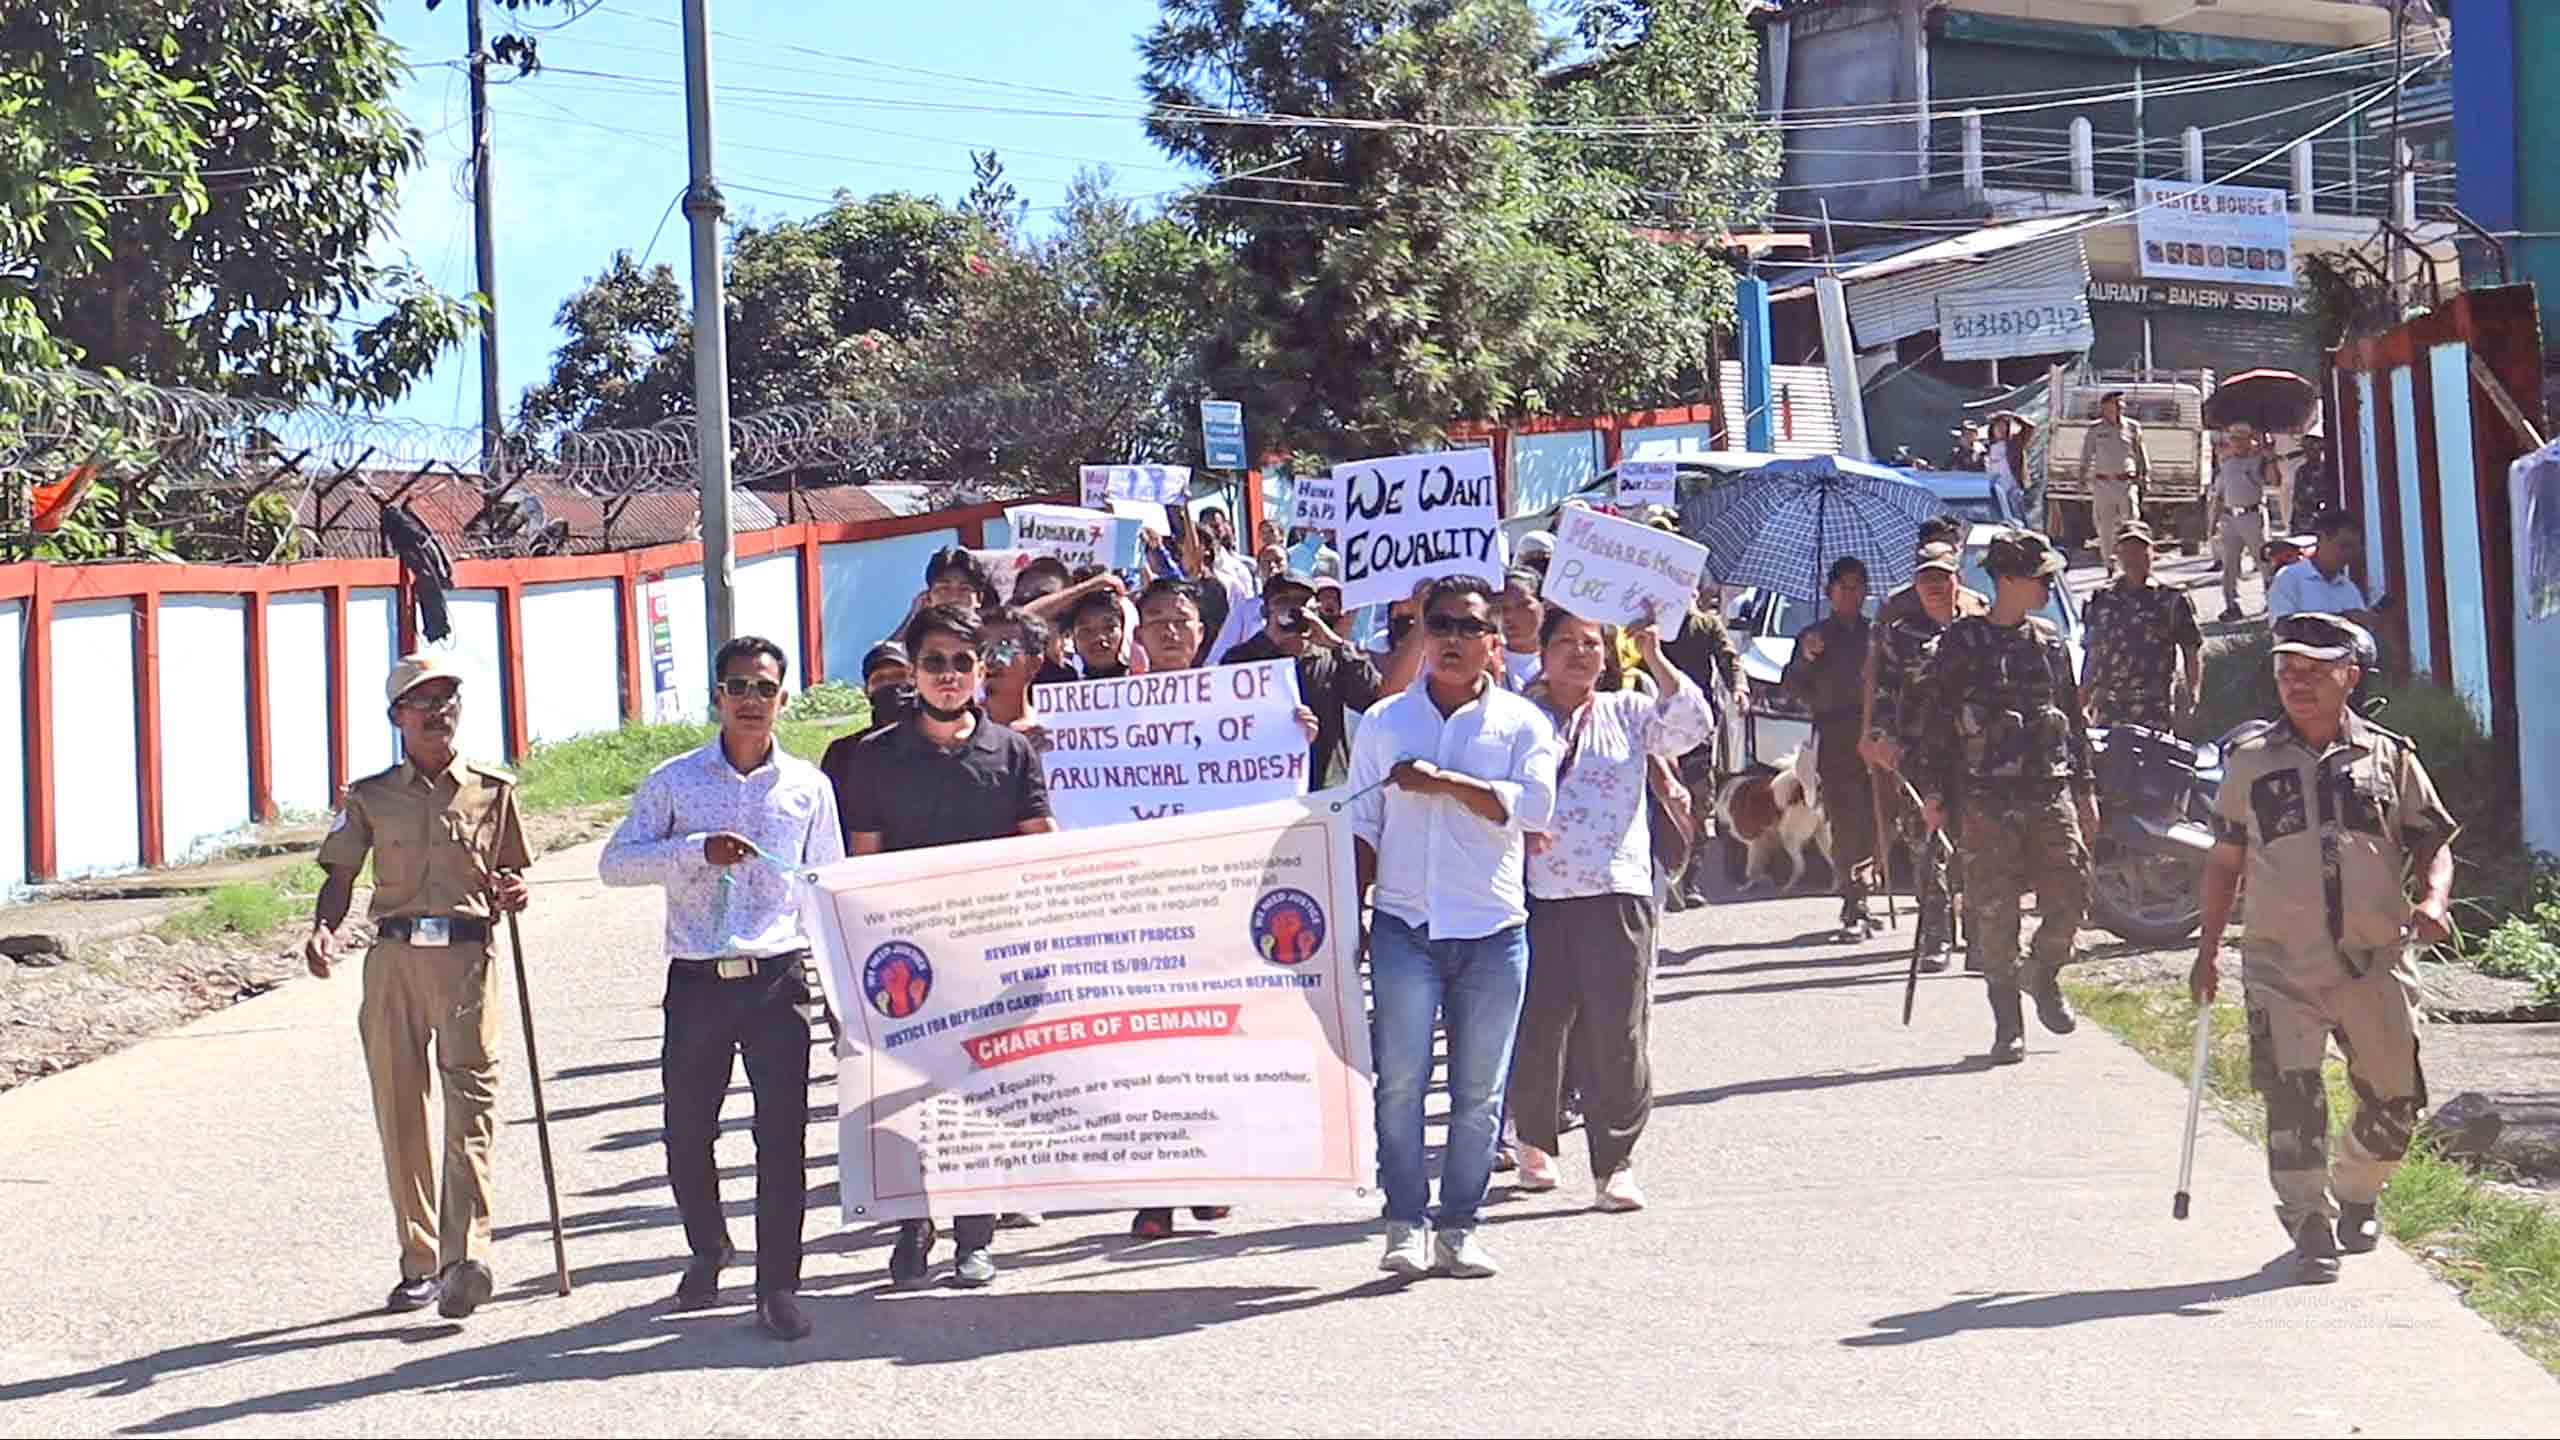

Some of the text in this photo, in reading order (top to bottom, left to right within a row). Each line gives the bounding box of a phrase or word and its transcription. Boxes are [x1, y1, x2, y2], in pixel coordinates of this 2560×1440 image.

[2215, 196, 2268, 215] HOUSE
[2168, 287, 2229, 310] BAKERY
[2233, 294, 2287, 313] SISTER
[1037, 665, 1274, 714] DIRECTORATE OF
[1043, 724, 1119, 752] SPORTS
[1217, 714, 1256, 743] OF
[1049, 751, 1308, 791] ARUNACHAL PRADESH
[890, 901, 943, 922] request
[946, 895, 974, 912] that
[1014, 886, 1041, 900] and
[1127, 865, 1199, 886] guidelines
[1202, 862, 1220, 876] be
[1223, 855, 1303, 873] established
[891, 913, 958, 938] regarding
[960, 902, 1021, 923] eligibility
[1023, 898, 1044, 912] for
[1047, 893, 1070, 909] the
[1073, 890, 1116, 909] sports
[1167, 877, 1228, 896] ensuring
[1231, 873, 1258, 889] that
[1261, 872, 1279, 887] all
[1027, 905, 1105, 928] understand
[1109, 900, 1143, 916] what
[1146, 898, 1159, 913] is
[984, 925, 1197, 962] REVIEW OF RECRUITMENT PROCESS
[999, 969, 1020, 986] WE
[1020, 963, 1058, 984] WANT
[1060, 957, 1109, 978] JUSTICE
[884, 1026, 927, 1050] JUSTICE
[926, 1016, 949, 1036] FOR
[949, 1002, 1005, 1028] DEPRIVED
[1006, 986, 1074, 1012] CANDIDATE
[1075, 979, 1125, 1001] SPORTS
[1245, 972, 1322, 989] DEPARTMENT
[978, 1008, 1229, 1062] CHARTER OF DEMAND
[985, 1097, 1029, 1118] Sports
[1031, 1083, 1081, 1105] Person
[1085, 1080, 1108, 1095] are
[1111, 1073, 1152, 1091] equal
[1156, 1071, 1192, 1086] don't
[1195, 1070, 1230, 1084] treat
[1232, 1072, 1250, 1084] us
[1253, 1068, 1313, 1085] another.
[1125, 1110, 1149, 1124] our
[937, 1142, 984, 1158] Within
[1100, 1128, 1138, 1144] must
[937, 1160, 960, 1173] We
[964, 1155, 991, 1171] will
[993, 1152, 1029, 1170] fight
[1031, 1152, 1053, 1166] till
[1055, 1149, 1080, 1163] the
[1081, 1149, 1108, 1163] end
[1111, 1147, 1128, 1162] of
[1130, 1149, 1154, 1162] our
